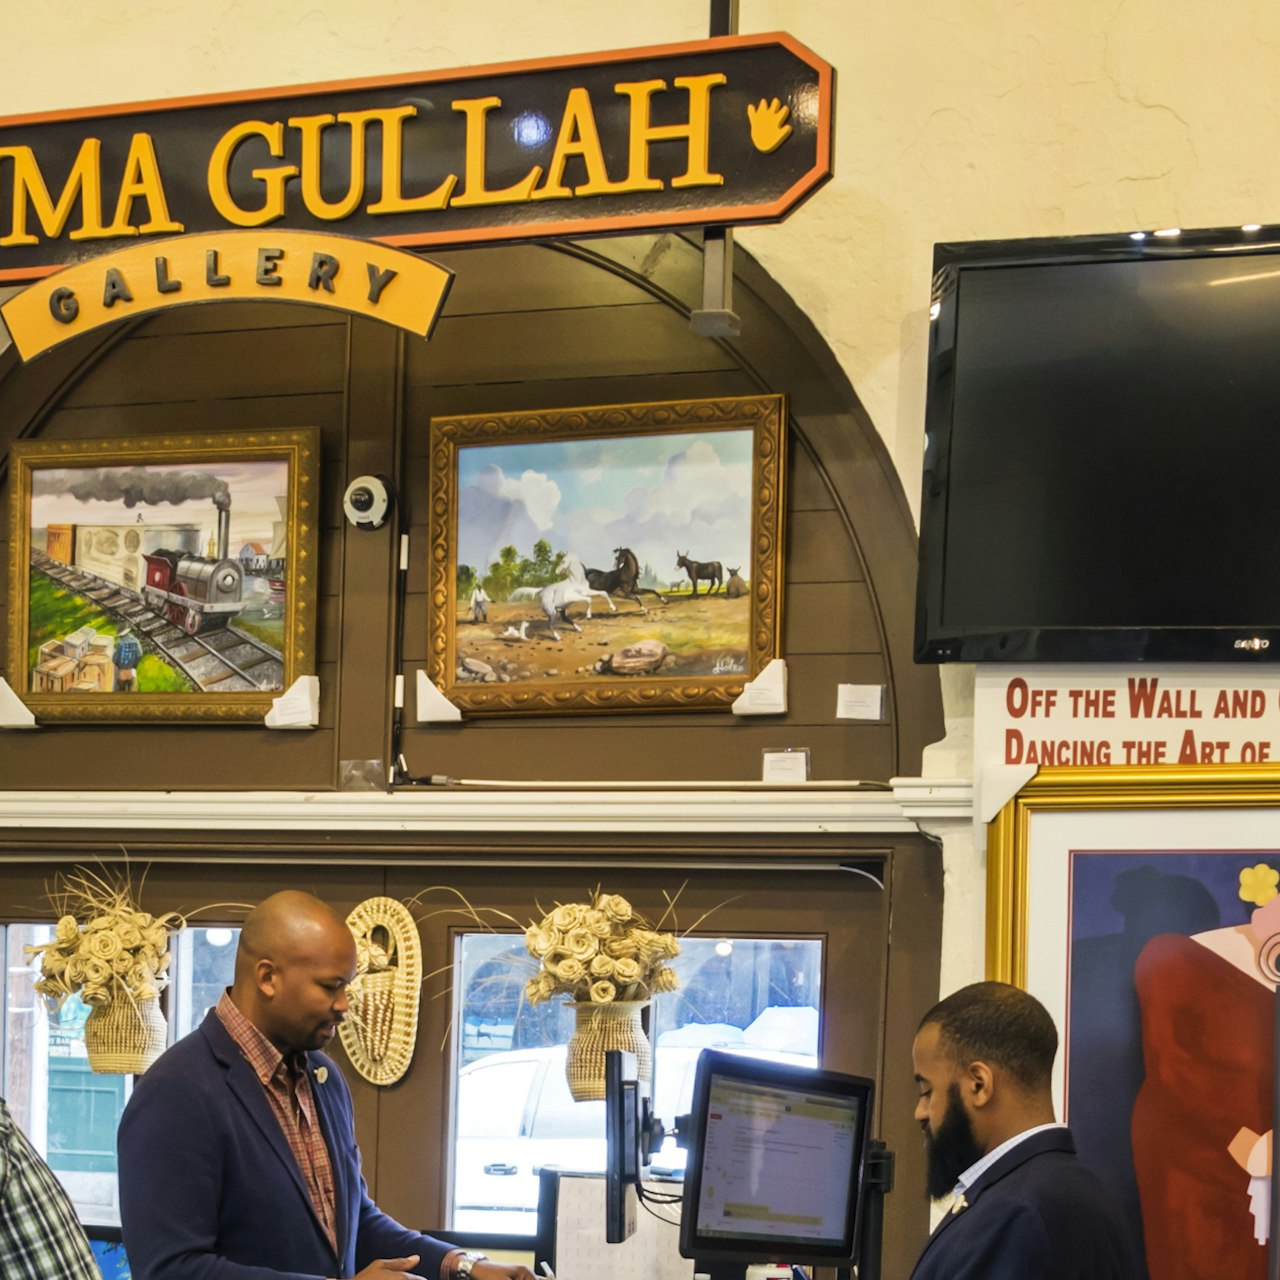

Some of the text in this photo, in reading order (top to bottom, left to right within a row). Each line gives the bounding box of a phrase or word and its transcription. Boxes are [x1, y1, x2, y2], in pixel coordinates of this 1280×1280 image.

[208, 73, 727, 227] GULLAH
[48, 247, 400, 324] GALLERY
[1006, 677, 1057, 718] OFF
[1070, 688, 1116, 718] THE
[1128, 678, 1202, 719] WALL
[1213, 689, 1266, 719] AND
[1005, 729, 1112, 765] DANCING
[1122, 740, 1167, 765] THE
[1178, 730, 1230, 764] ART
